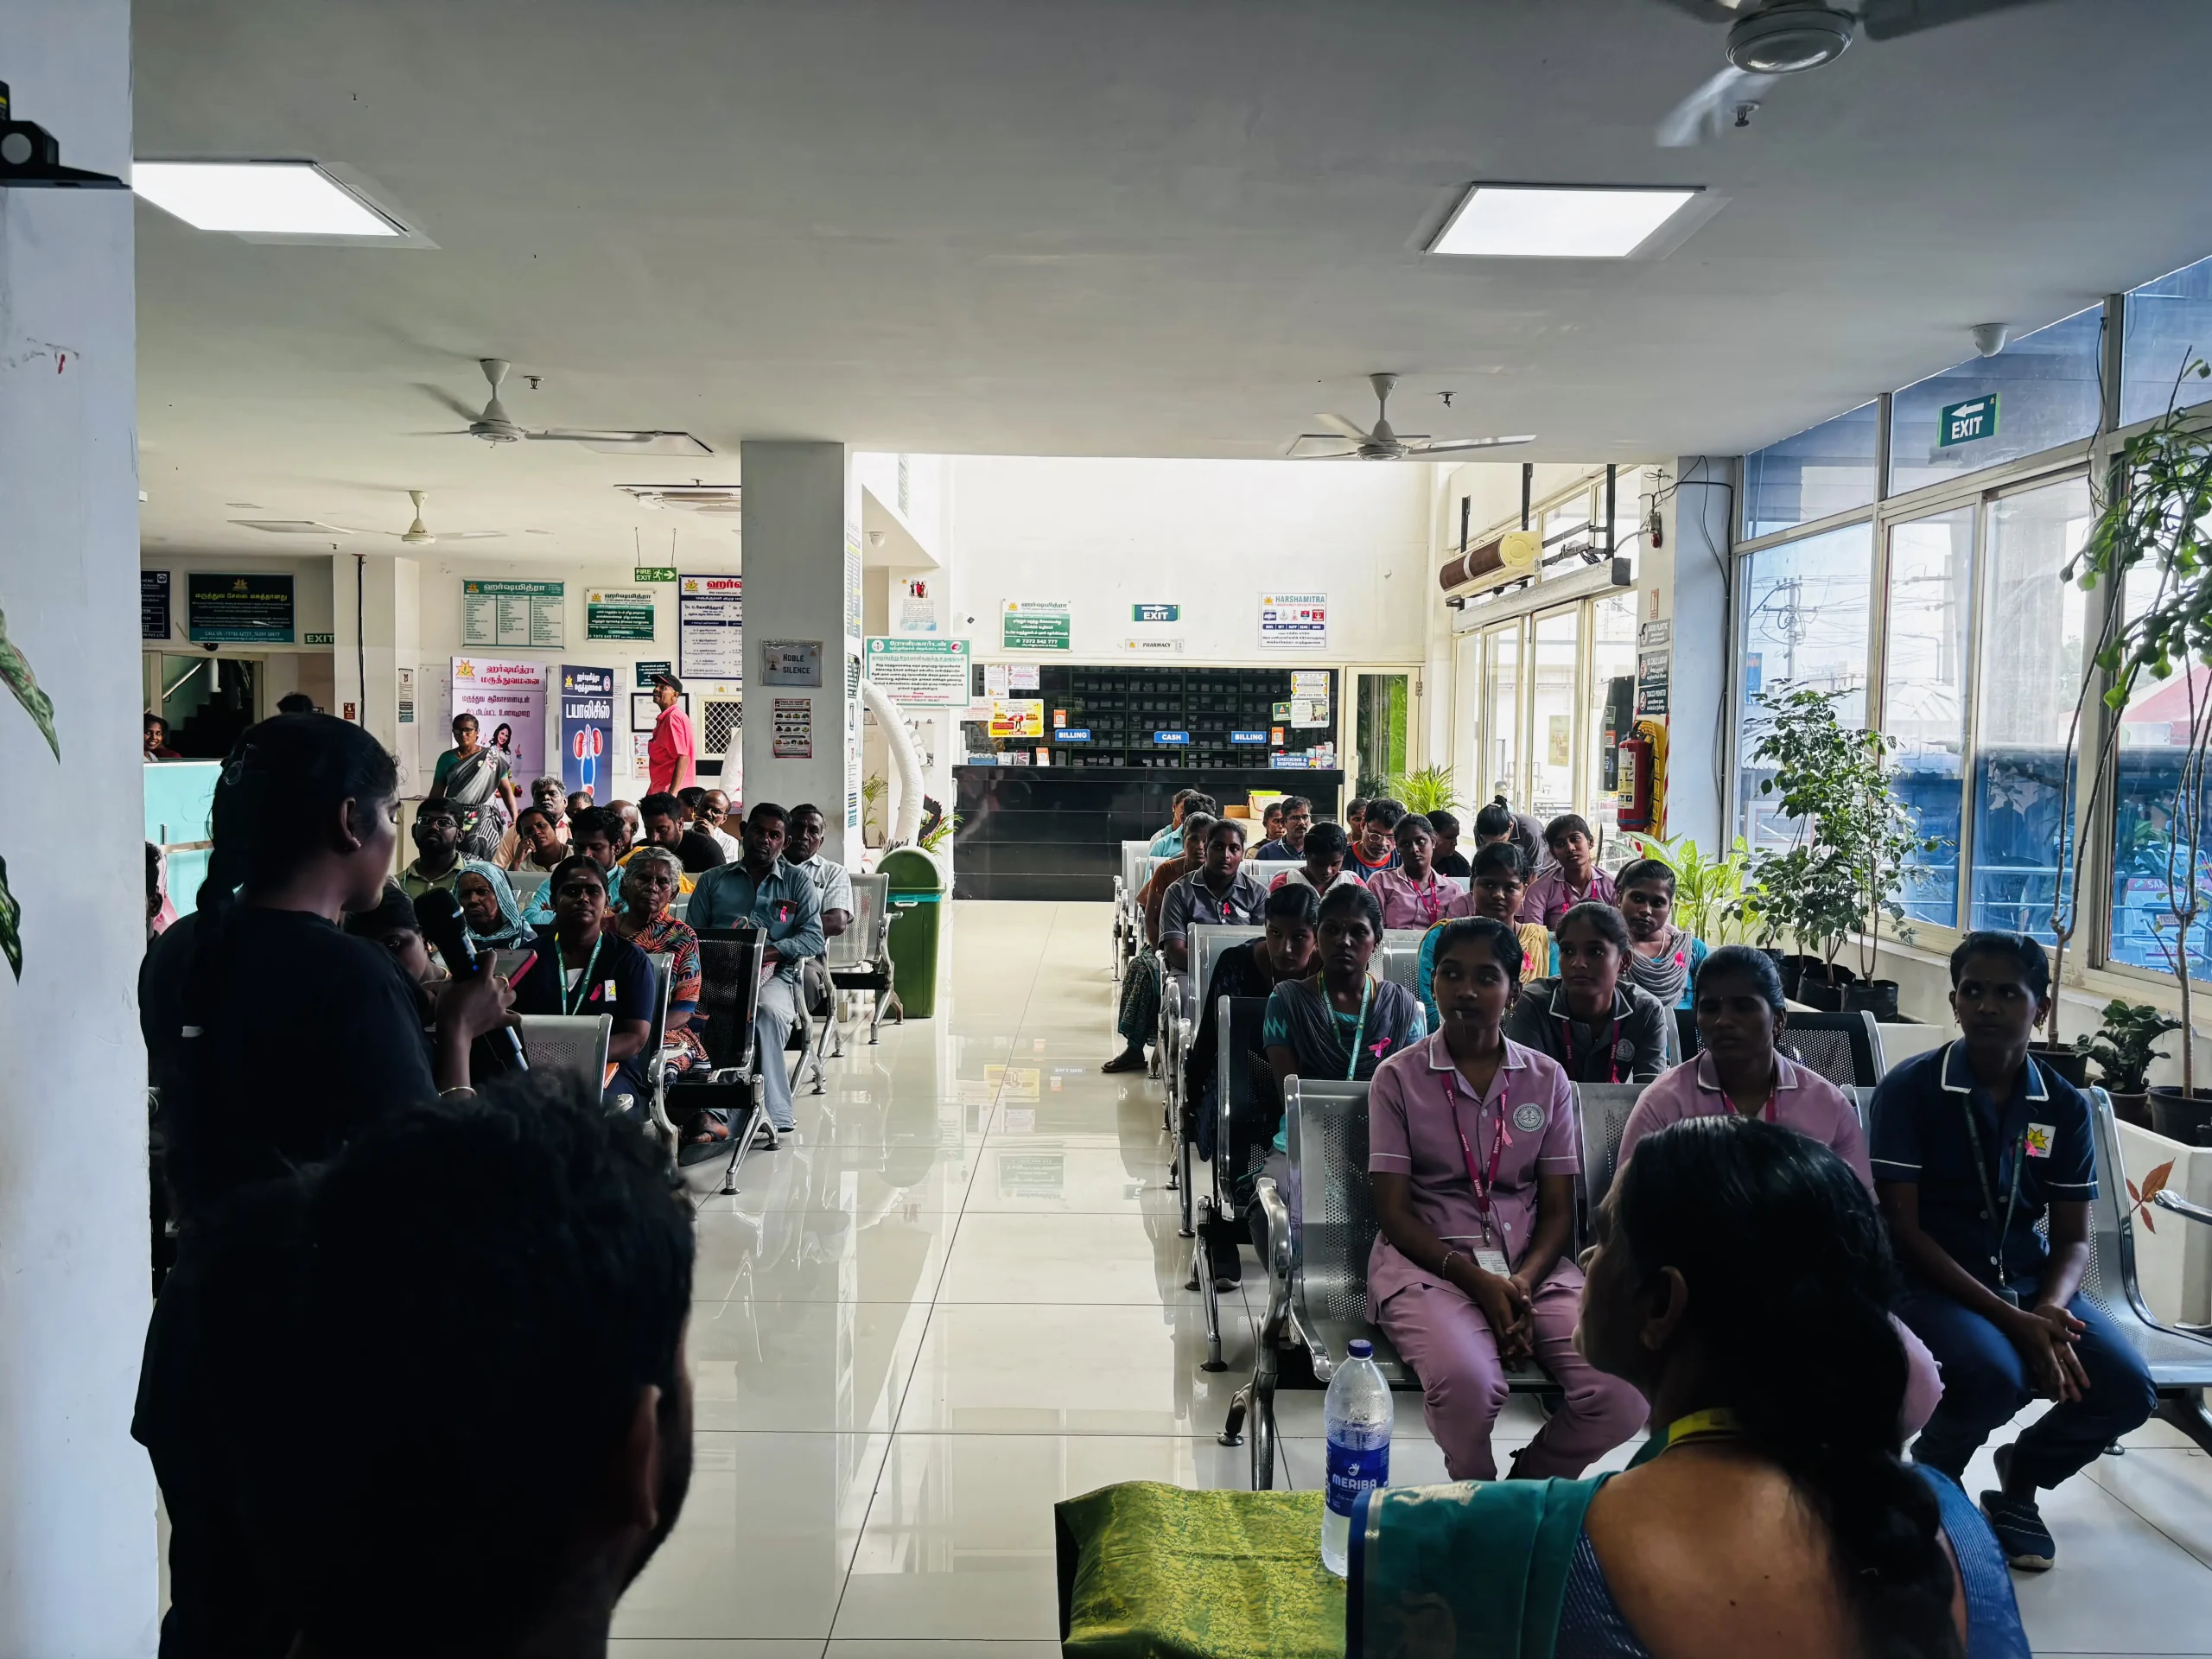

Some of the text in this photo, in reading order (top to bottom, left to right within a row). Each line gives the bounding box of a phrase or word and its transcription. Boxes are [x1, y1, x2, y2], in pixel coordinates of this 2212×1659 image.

[1952, 416, 1983, 440] EXIT
[1143, 612, 1169, 620] EXIT
[307, 634, 334, 643] EXIT
[783, 653, 804, 662] NOBLE
[480, 675, 540, 686] மருத்துவமனை
[566, 700, 610, 719] டயாலிசிஸ்
[1473, 1179, 1484, 1198] RIPMER
[1332, 1473, 1377, 1491] MERIBA
